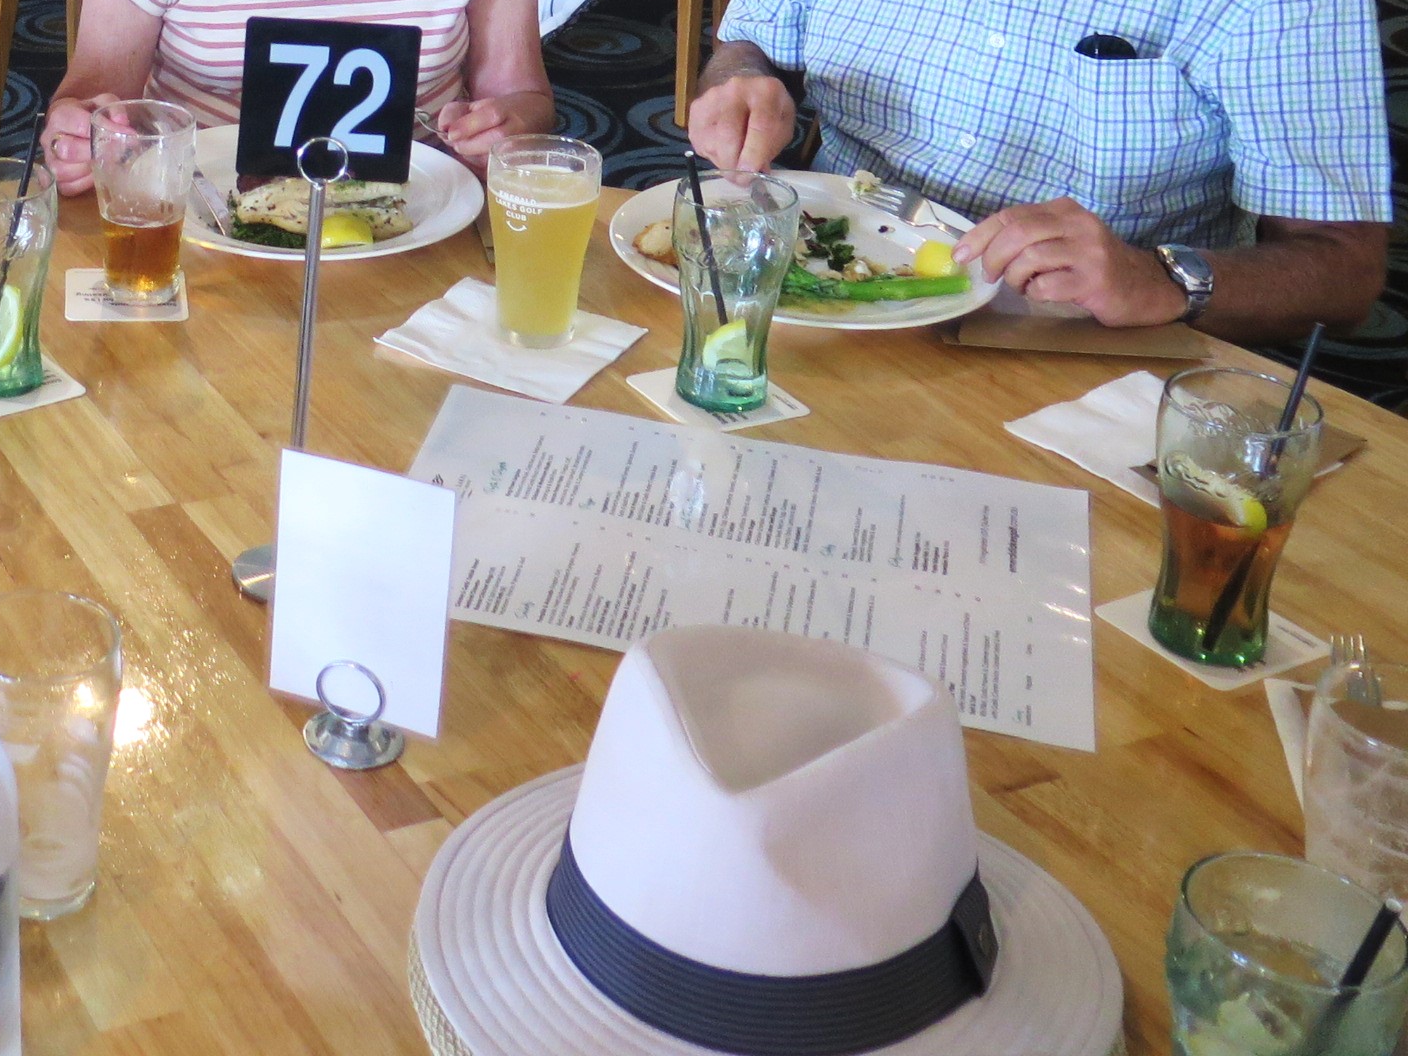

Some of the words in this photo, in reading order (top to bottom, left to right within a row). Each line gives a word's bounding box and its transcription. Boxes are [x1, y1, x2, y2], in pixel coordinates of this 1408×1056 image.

[269, 42, 391, 155] 72
[495, 197, 518, 211] LAKES
[519, 205, 544, 215] GOLF
[505, 210, 527, 222] CLUB
